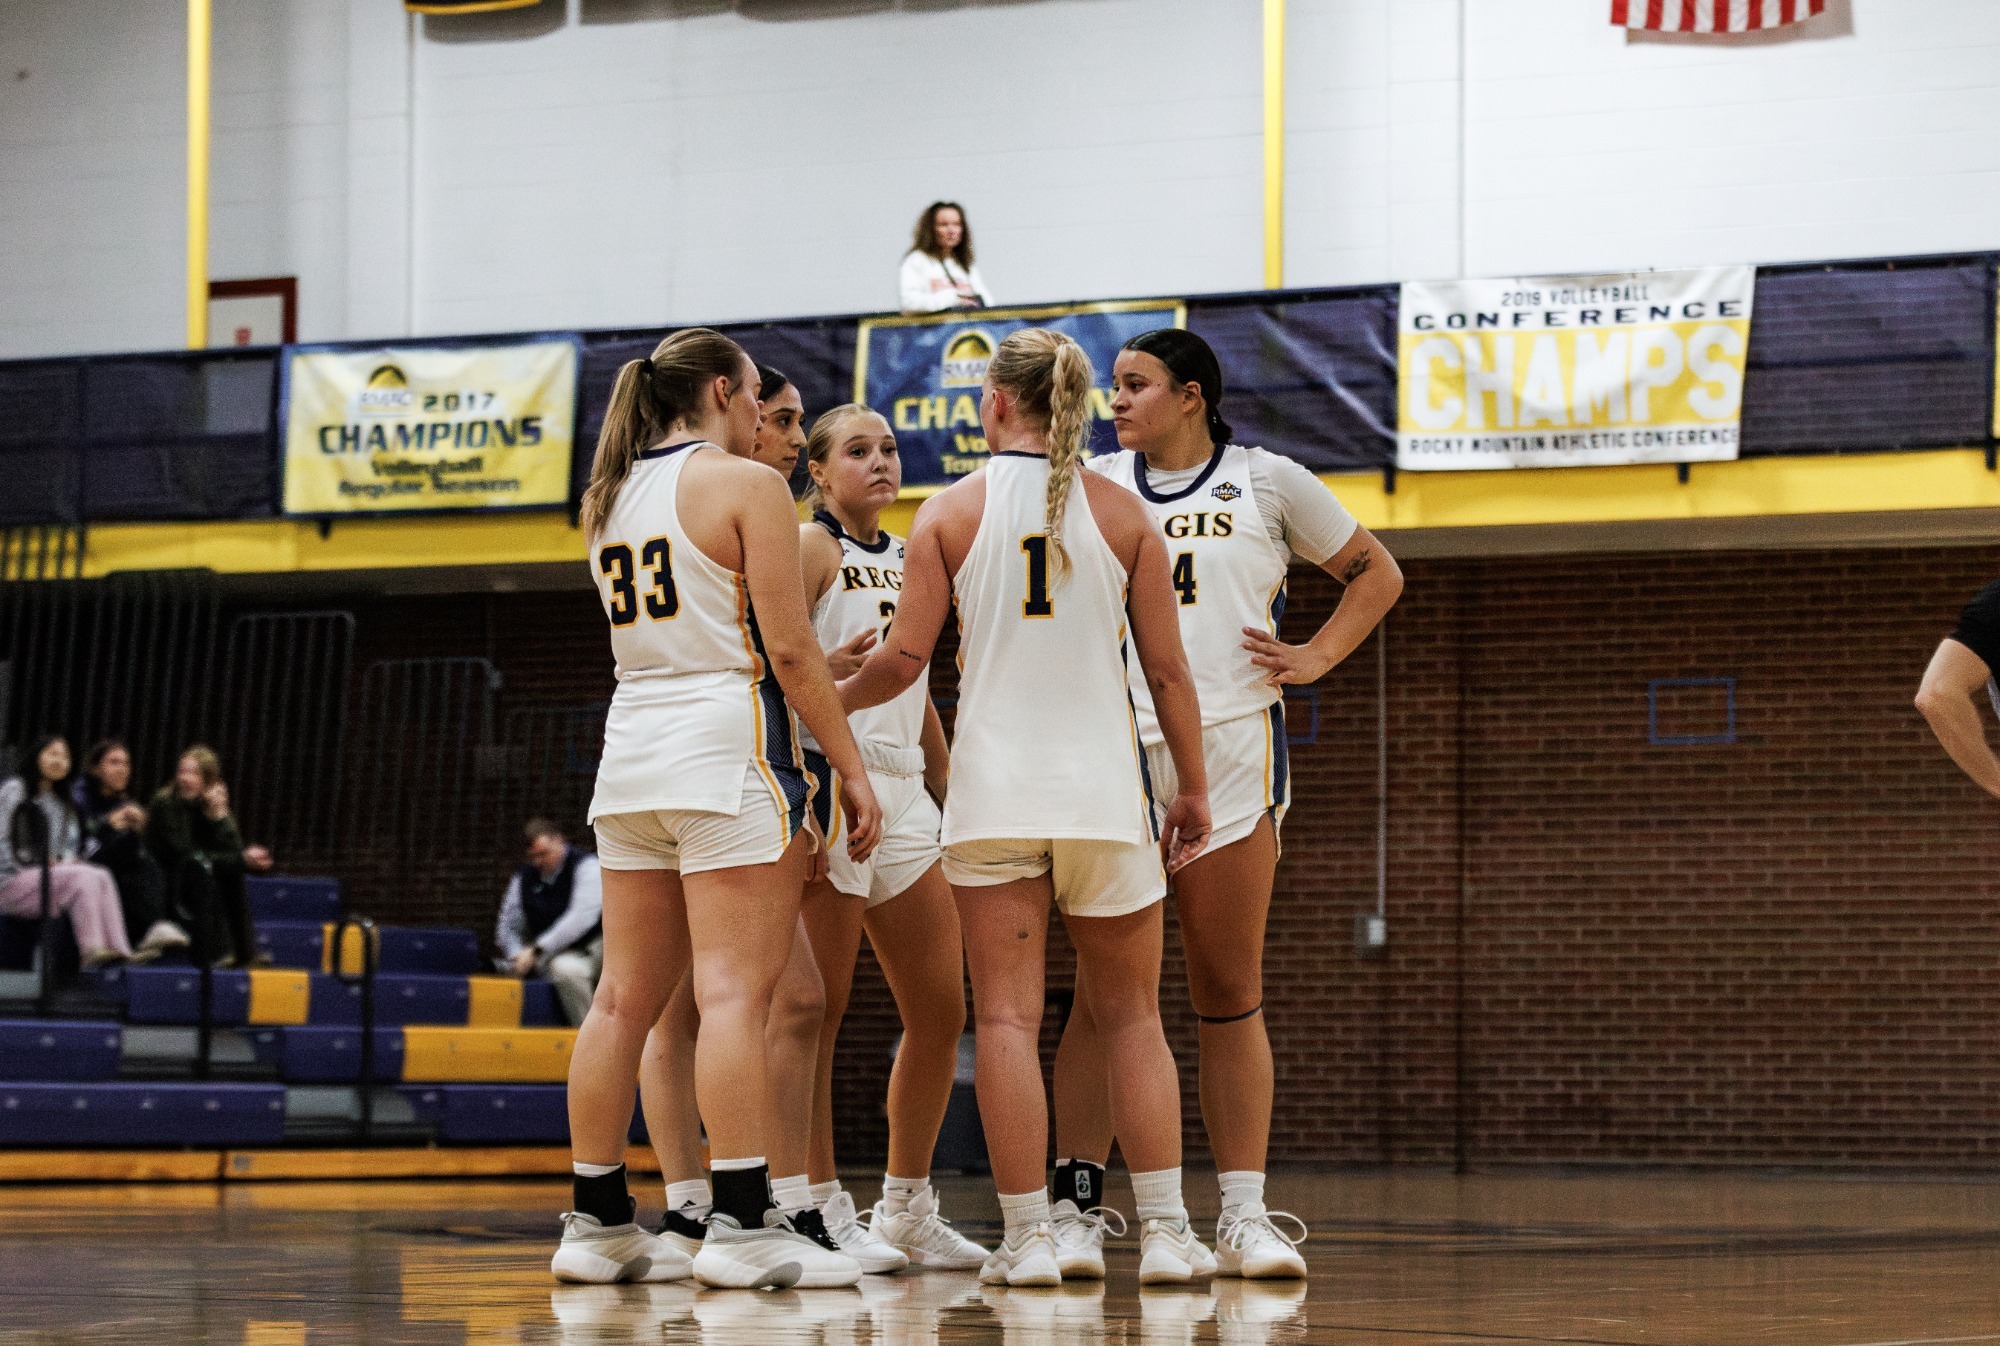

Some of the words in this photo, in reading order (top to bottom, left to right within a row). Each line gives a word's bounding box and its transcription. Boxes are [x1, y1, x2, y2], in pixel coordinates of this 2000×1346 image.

[1501, 291, 1542, 307] 2019
[1549, 285, 1649, 305] VOLLEYBALL
[1413, 300, 1743, 331] CONFERENCE
[1408, 324, 1743, 431] CHAMPS
[424, 392, 496, 413] 2017
[318, 416, 542, 455] CHAMPIONS
[1410, 438, 1464, 454] ROCKY
[1471, 436, 1546, 452] MOUNTAIN
[1552, 432, 1626, 450] ATHLETIC
[1632, 428, 1738, 448] CONFERENCE
[1212, 488, 1242, 497] RMAC
[1163, 511, 1233, 540] GIS
[599, 534, 682, 629] 33
[840, 565, 903, 593] REG
[1020, 533, 1055, 620] 1
